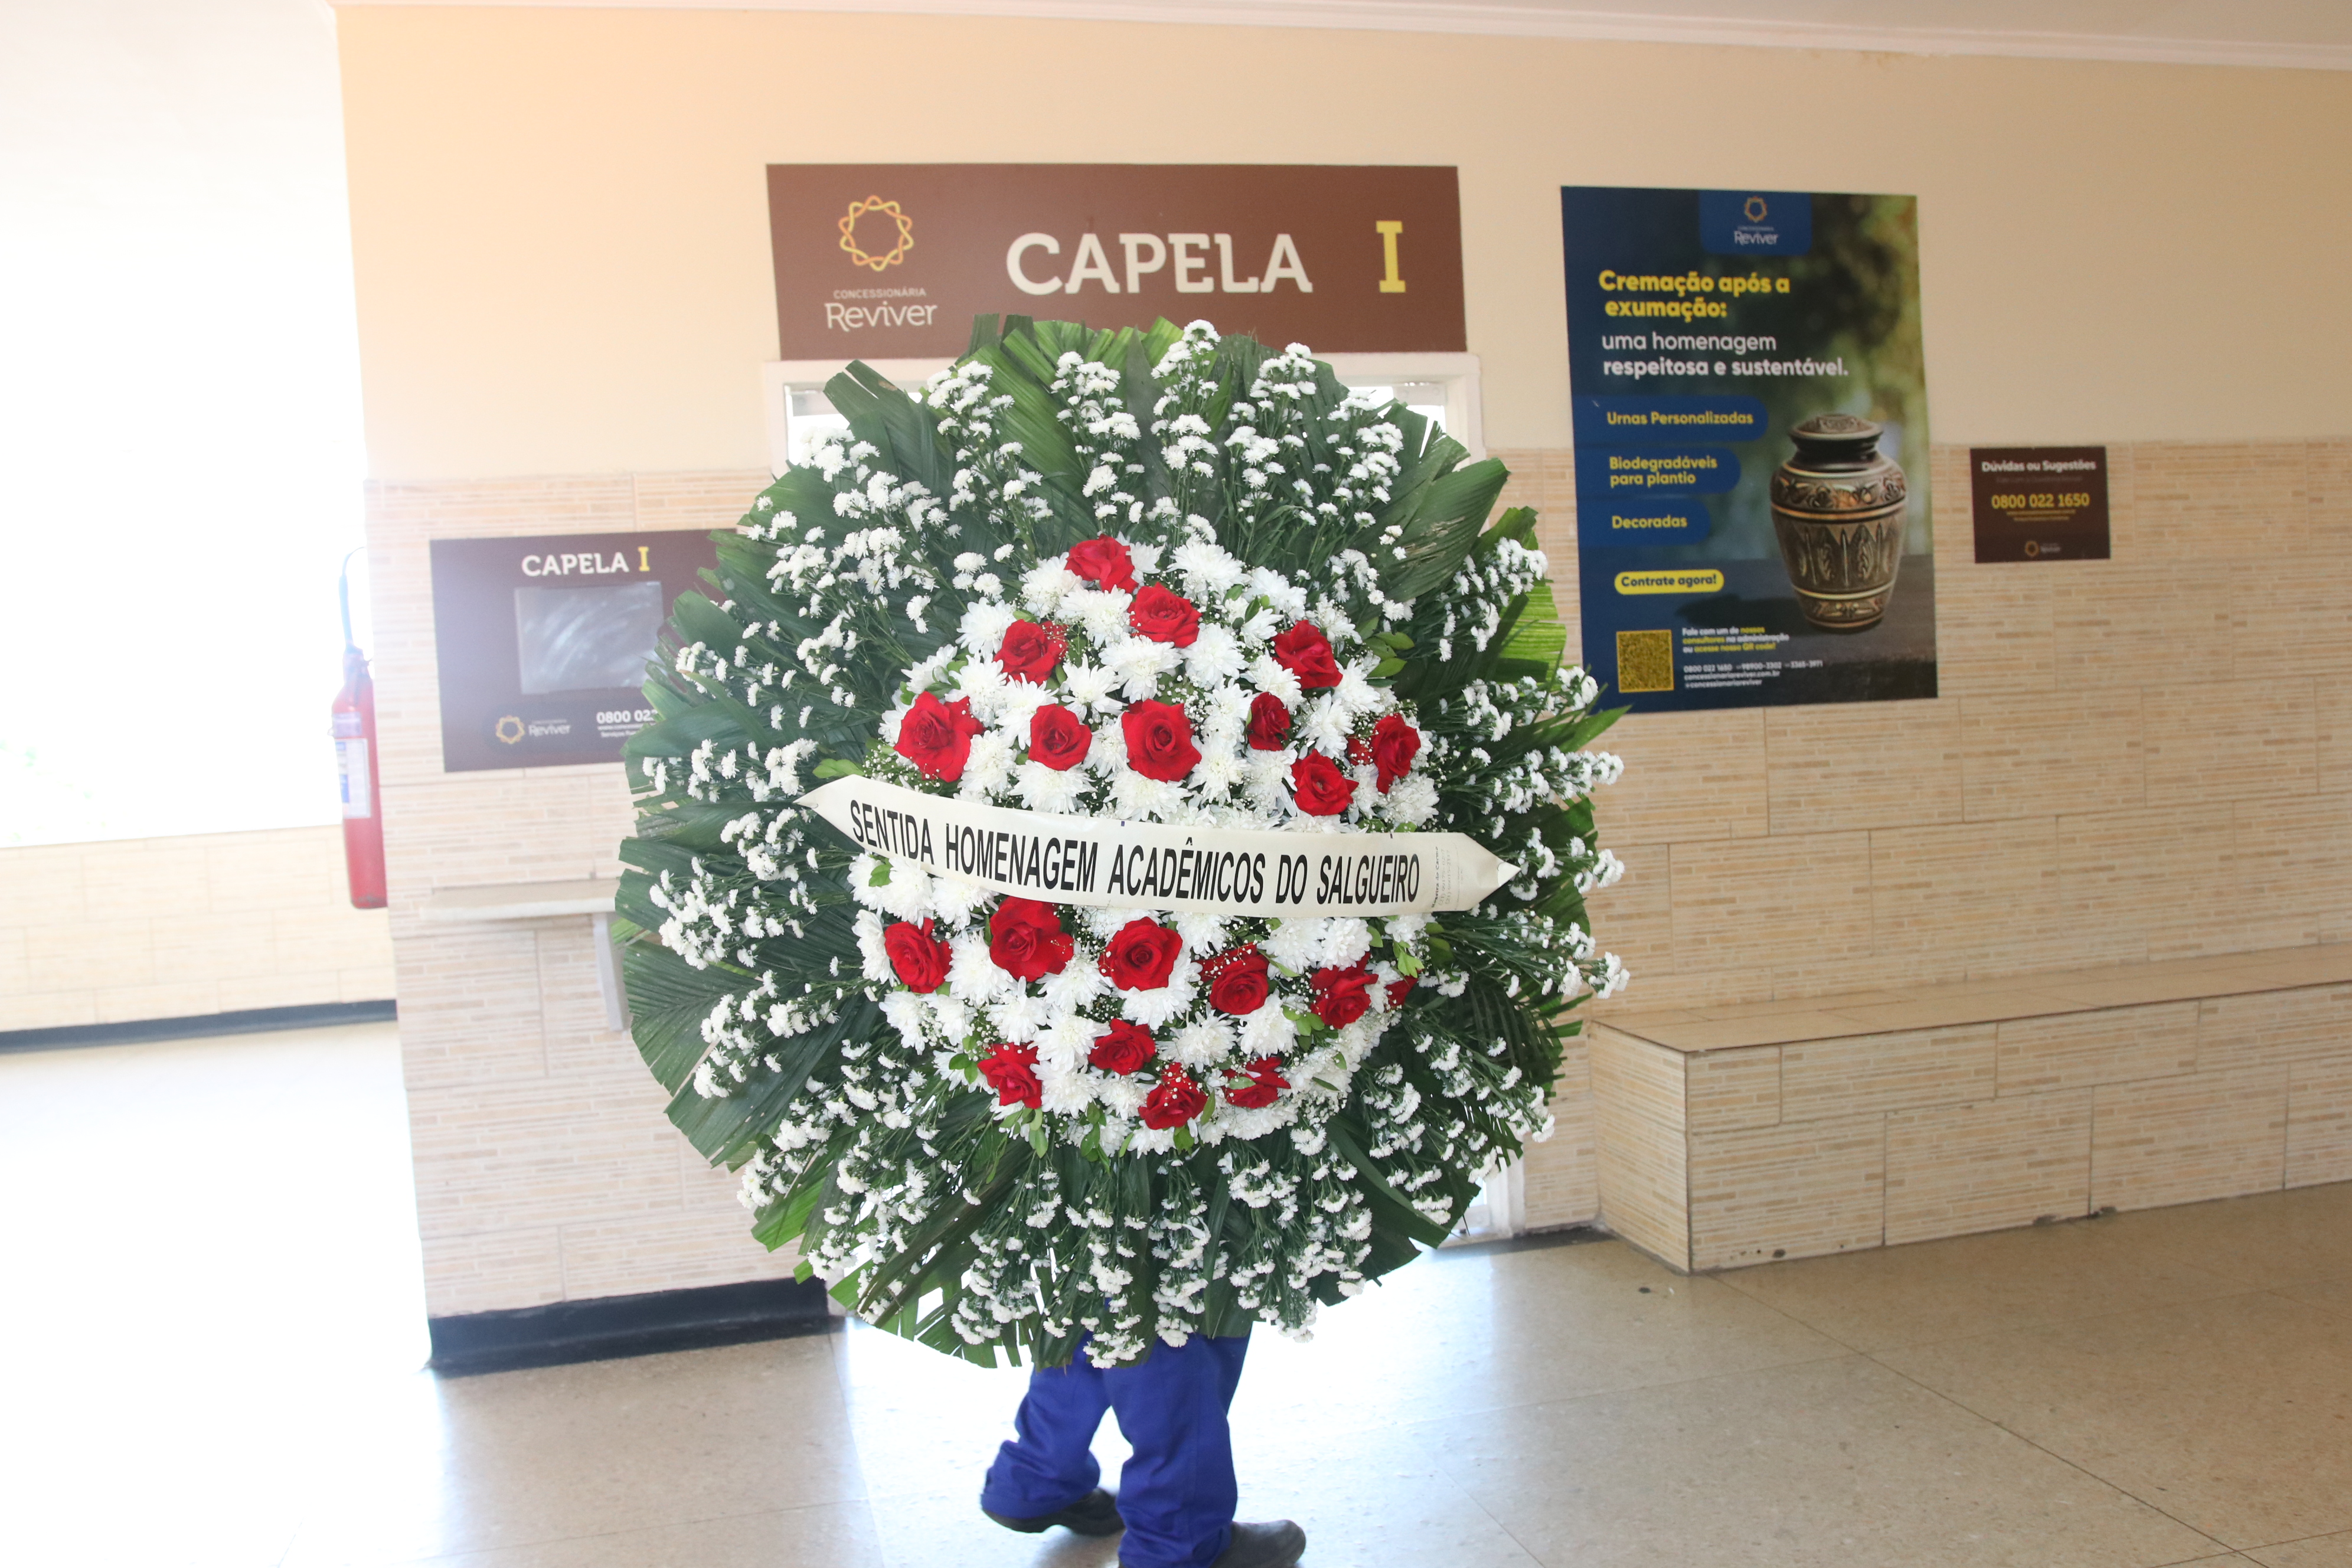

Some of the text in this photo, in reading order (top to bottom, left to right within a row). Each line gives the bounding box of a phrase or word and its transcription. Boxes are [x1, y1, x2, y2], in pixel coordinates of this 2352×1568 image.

[1734, 231, 1778, 246] Reviver
[1007, 220, 1406, 295] CAPELA I
[1599, 270, 1789, 297] Cremação após a
[833, 286, 927, 299] CONCESSIONÁRIA
[824, 300, 937, 332] Reviver
[1605, 298, 1727, 322] exumação:
[1602, 332, 1776, 355] uma homenagem
[1603, 357, 1848, 380] respeitosa e sustentável.
[1607, 410, 1754, 424] Urnas Personalizadas
[1609, 455, 1717, 472] Biodegradáveis
[1982, 459, 2096, 473] Dúvidas ou Sugestões
[1610, 471, 1696, 488] para plantio
[1991, 492, 2090, 509] 0800 022 1650
[1612, 514, 1687, 528] Decoradas
[522, 546, 650, 576] CAPELA I
[1621, 574, 1717, 587] Contrate agora!
[1682, 628, 1698, 636] Fale
[1730, 626, 1739, 635] de
[1683, 665, 1702, 673] 0800
[596, 710, 631, 724] 0800
[528, 724, 571, 737] Reviver
[850, 799, 934, 865] SENTIDA
[946, 823, 1098, 893] HOMENAGEM
[1108, 837, 1266, 903] ACADÊMICOS
[1276, 855, 1307, 904] DO
[1317, 854, 1420, 904] SALGUEIRO
